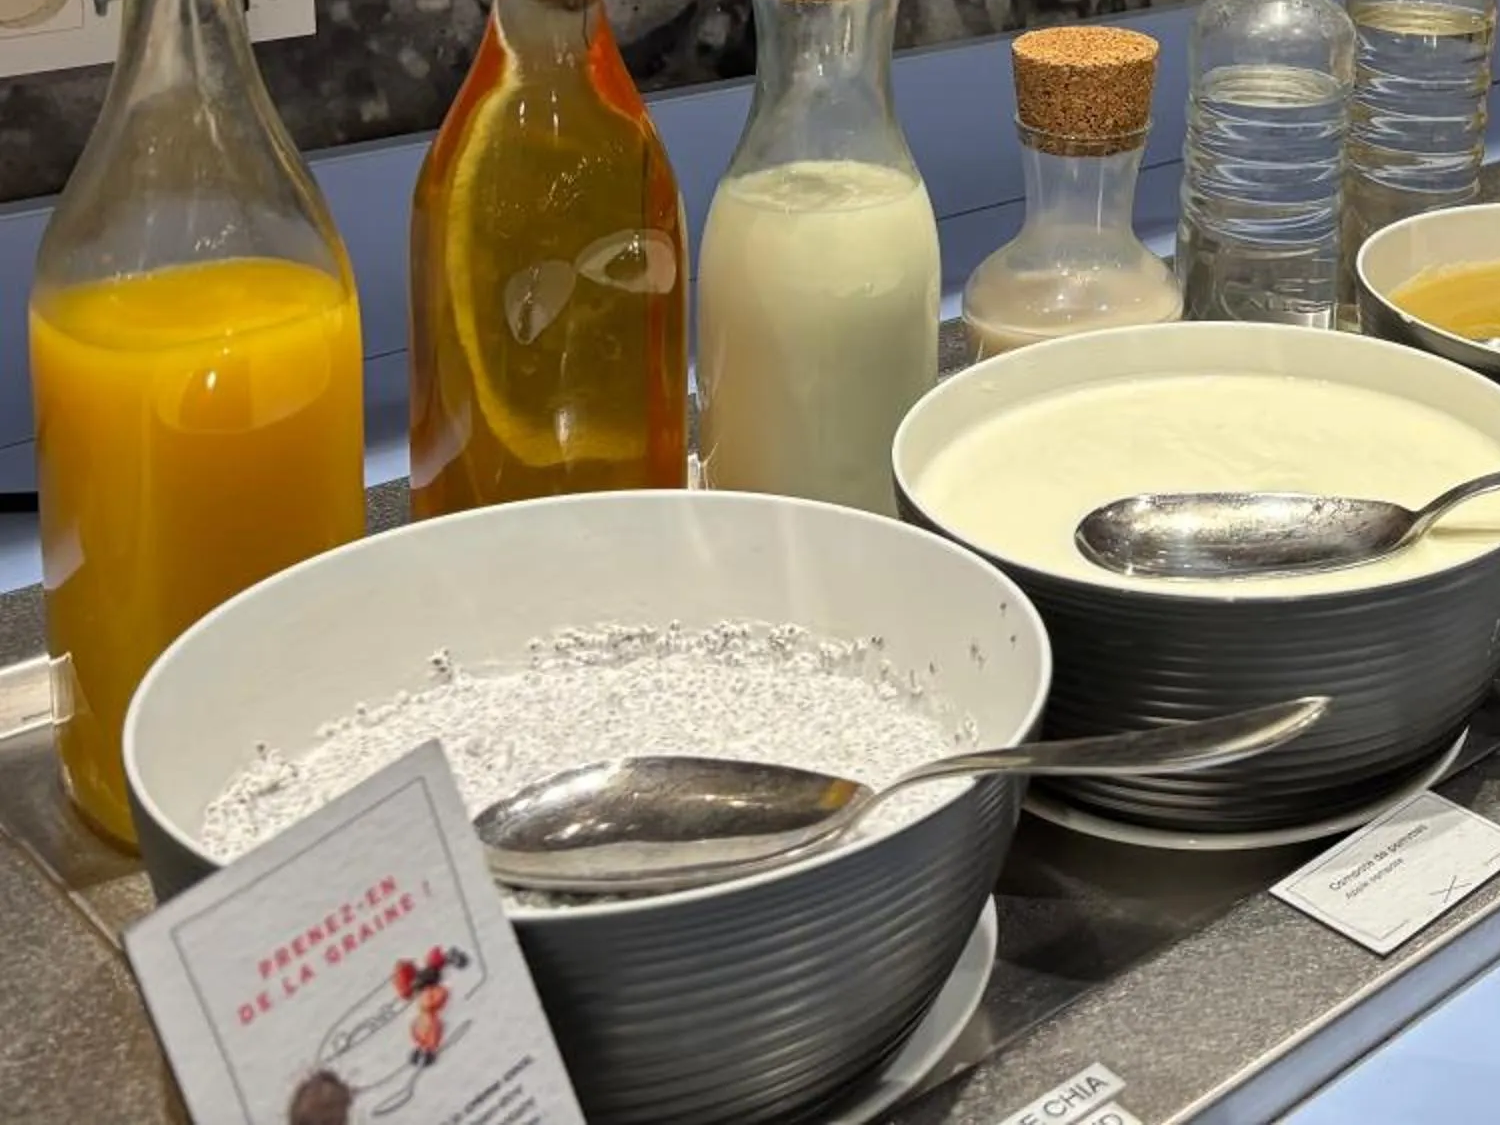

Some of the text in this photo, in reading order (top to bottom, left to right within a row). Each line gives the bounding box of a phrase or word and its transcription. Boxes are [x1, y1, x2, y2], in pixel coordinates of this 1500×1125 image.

[236, 990, 272, 1025] DE
[281, 962, 315, 998] LA
[325, 891, 415, 968] GRAINE
[257, 875, 397, 980] PRENEZ-EN
[1043, 1076, 1111, 1118] CHIA
